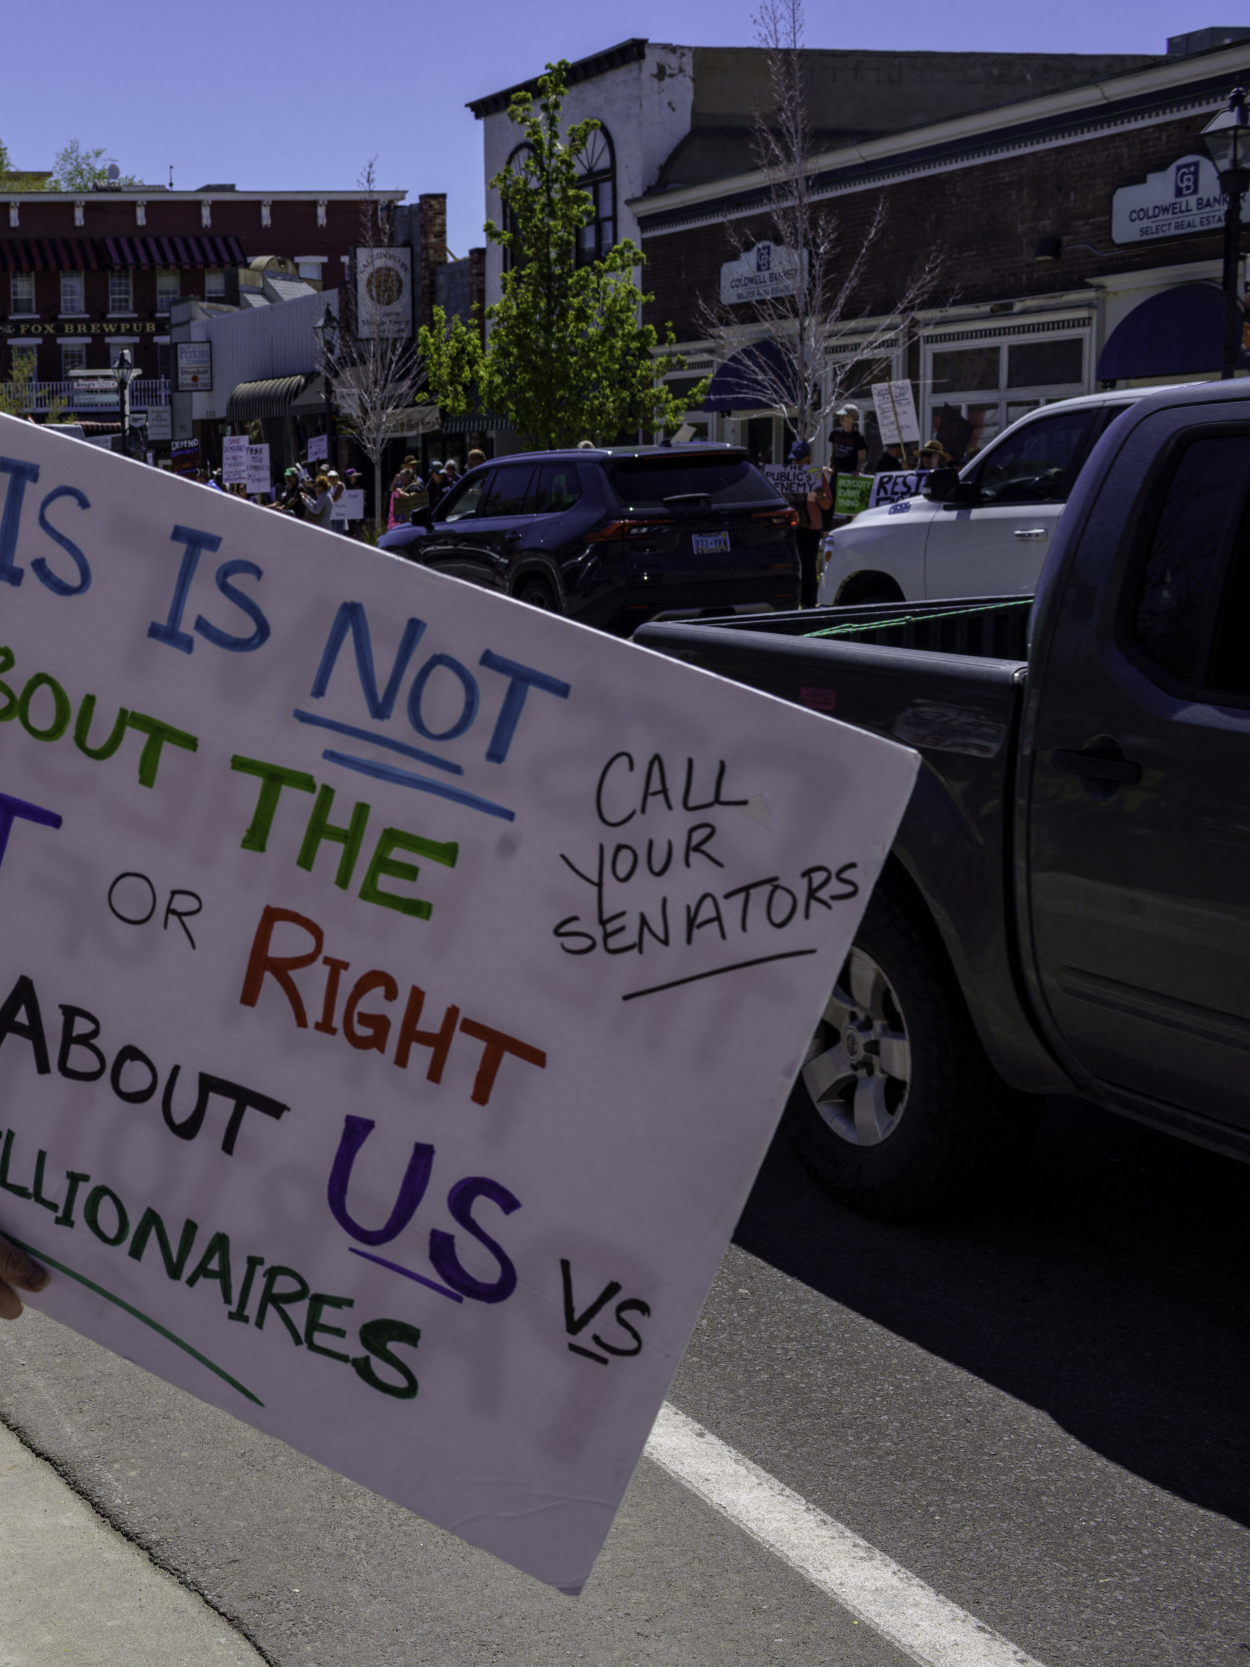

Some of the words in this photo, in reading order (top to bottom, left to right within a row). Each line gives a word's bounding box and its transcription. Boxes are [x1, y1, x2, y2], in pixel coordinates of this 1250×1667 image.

[1129, 199, 1193, 223] COLDWELL
[1139, 222, 1172, 237] SELECT
[1174, 218, 1198, 231] REAL
[1200, 213, 1227, 226] ESTA
[730, 274, 767, 289] COLDWELL
[19, 323, 56, 334] FOX
[64, 322, 157, 333] BREWPUB
[180, 346, 210, 360] Perkins
[171, 438, 199, 451] DEFEND
[766, 471, 811, 481] PUBLIC'S
[774, 482, 816, 492] ENEMY
[838, 479, 870, 489] BOYCOTT
[838, 488, 860, 498] EVERY
[147, 524, 271, 654] IS
[310, 601, 571, 765] NOT
[596, 752, 749, 827] CALL
[230, 754, 459, 921] THE
[559, 823, 724, 925] YOUR
[553, 862, 859, 955] SENATORS
[107, 871, 202, 950] OR
[239, 904, 547, 1107] RIGHT
[326, 1115, 523, 1304] US
[559, 1258, 652, 1358] VS
